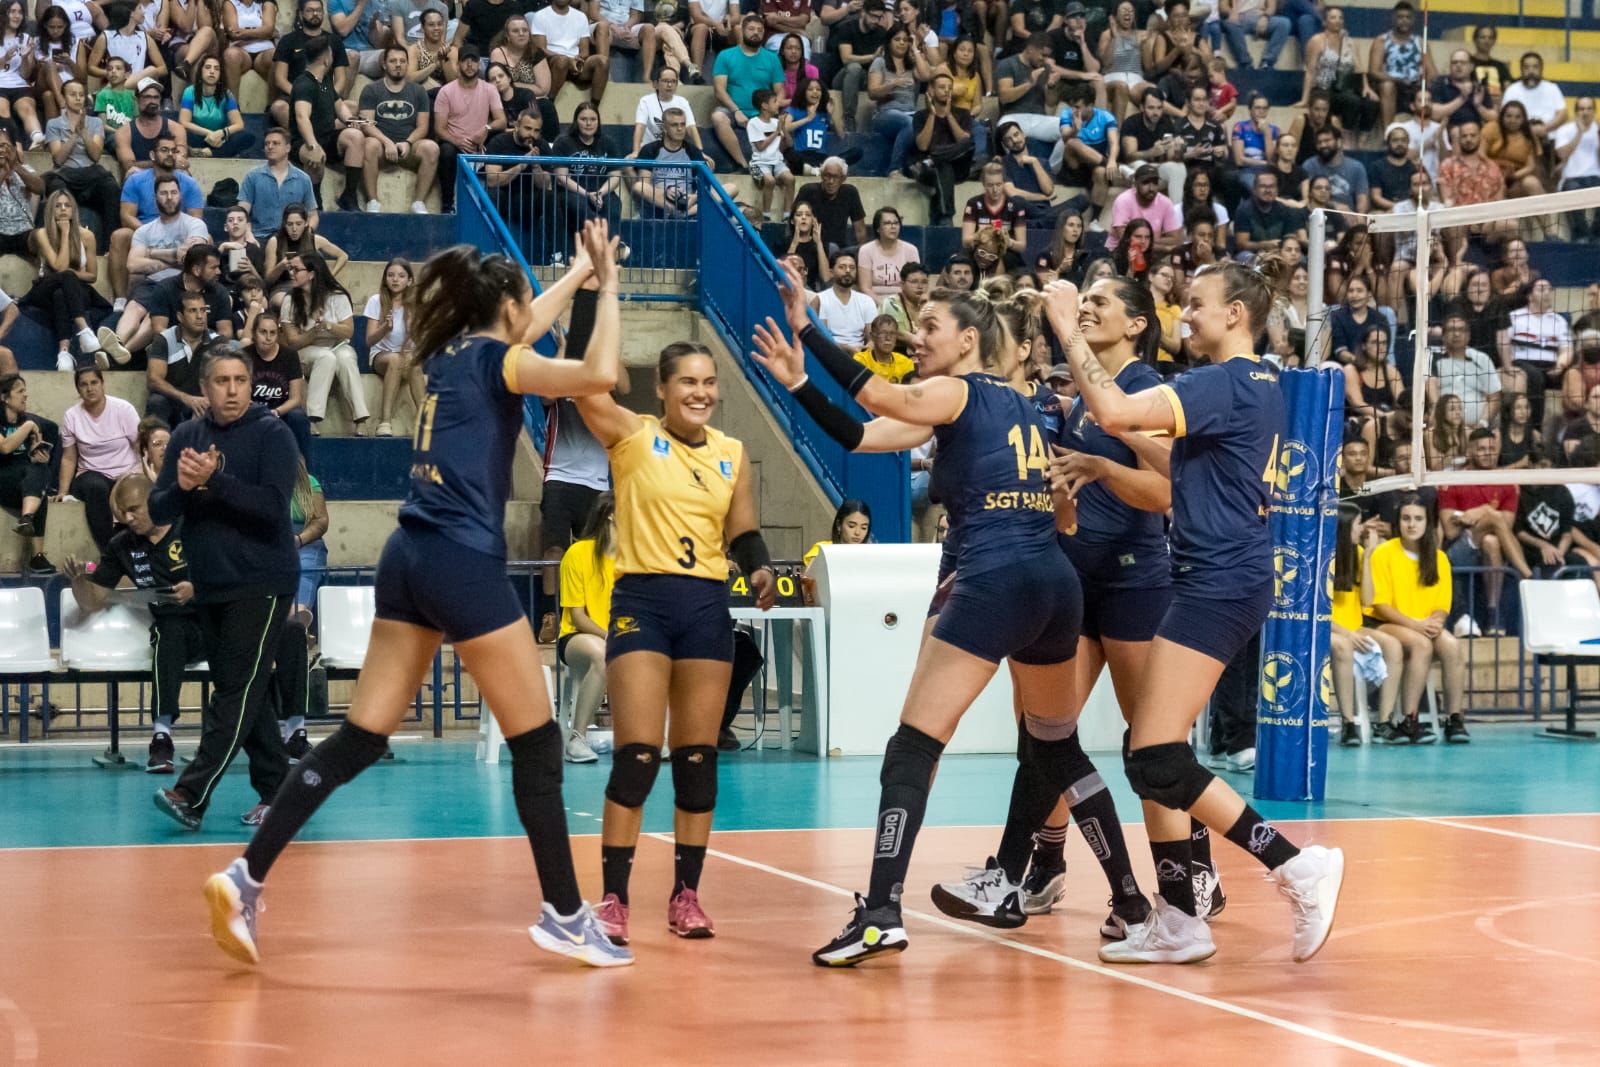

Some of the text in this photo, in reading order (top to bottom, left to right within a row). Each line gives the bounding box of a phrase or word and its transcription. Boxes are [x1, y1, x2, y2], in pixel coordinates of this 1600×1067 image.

[73, 11, 83, 21] 12
[806, 129, 823, 149] 15
[1008, 424, 1050, 481] 14
[984, 491, 1020, 510] SGT
[677, 536, 696, 570] 3
[732, 577, 749, 596] 4
[777, 577, 794, 597] 0
[879, 814, 900, 852] tilibra
[1192, 827, 1210, 841] ICO
